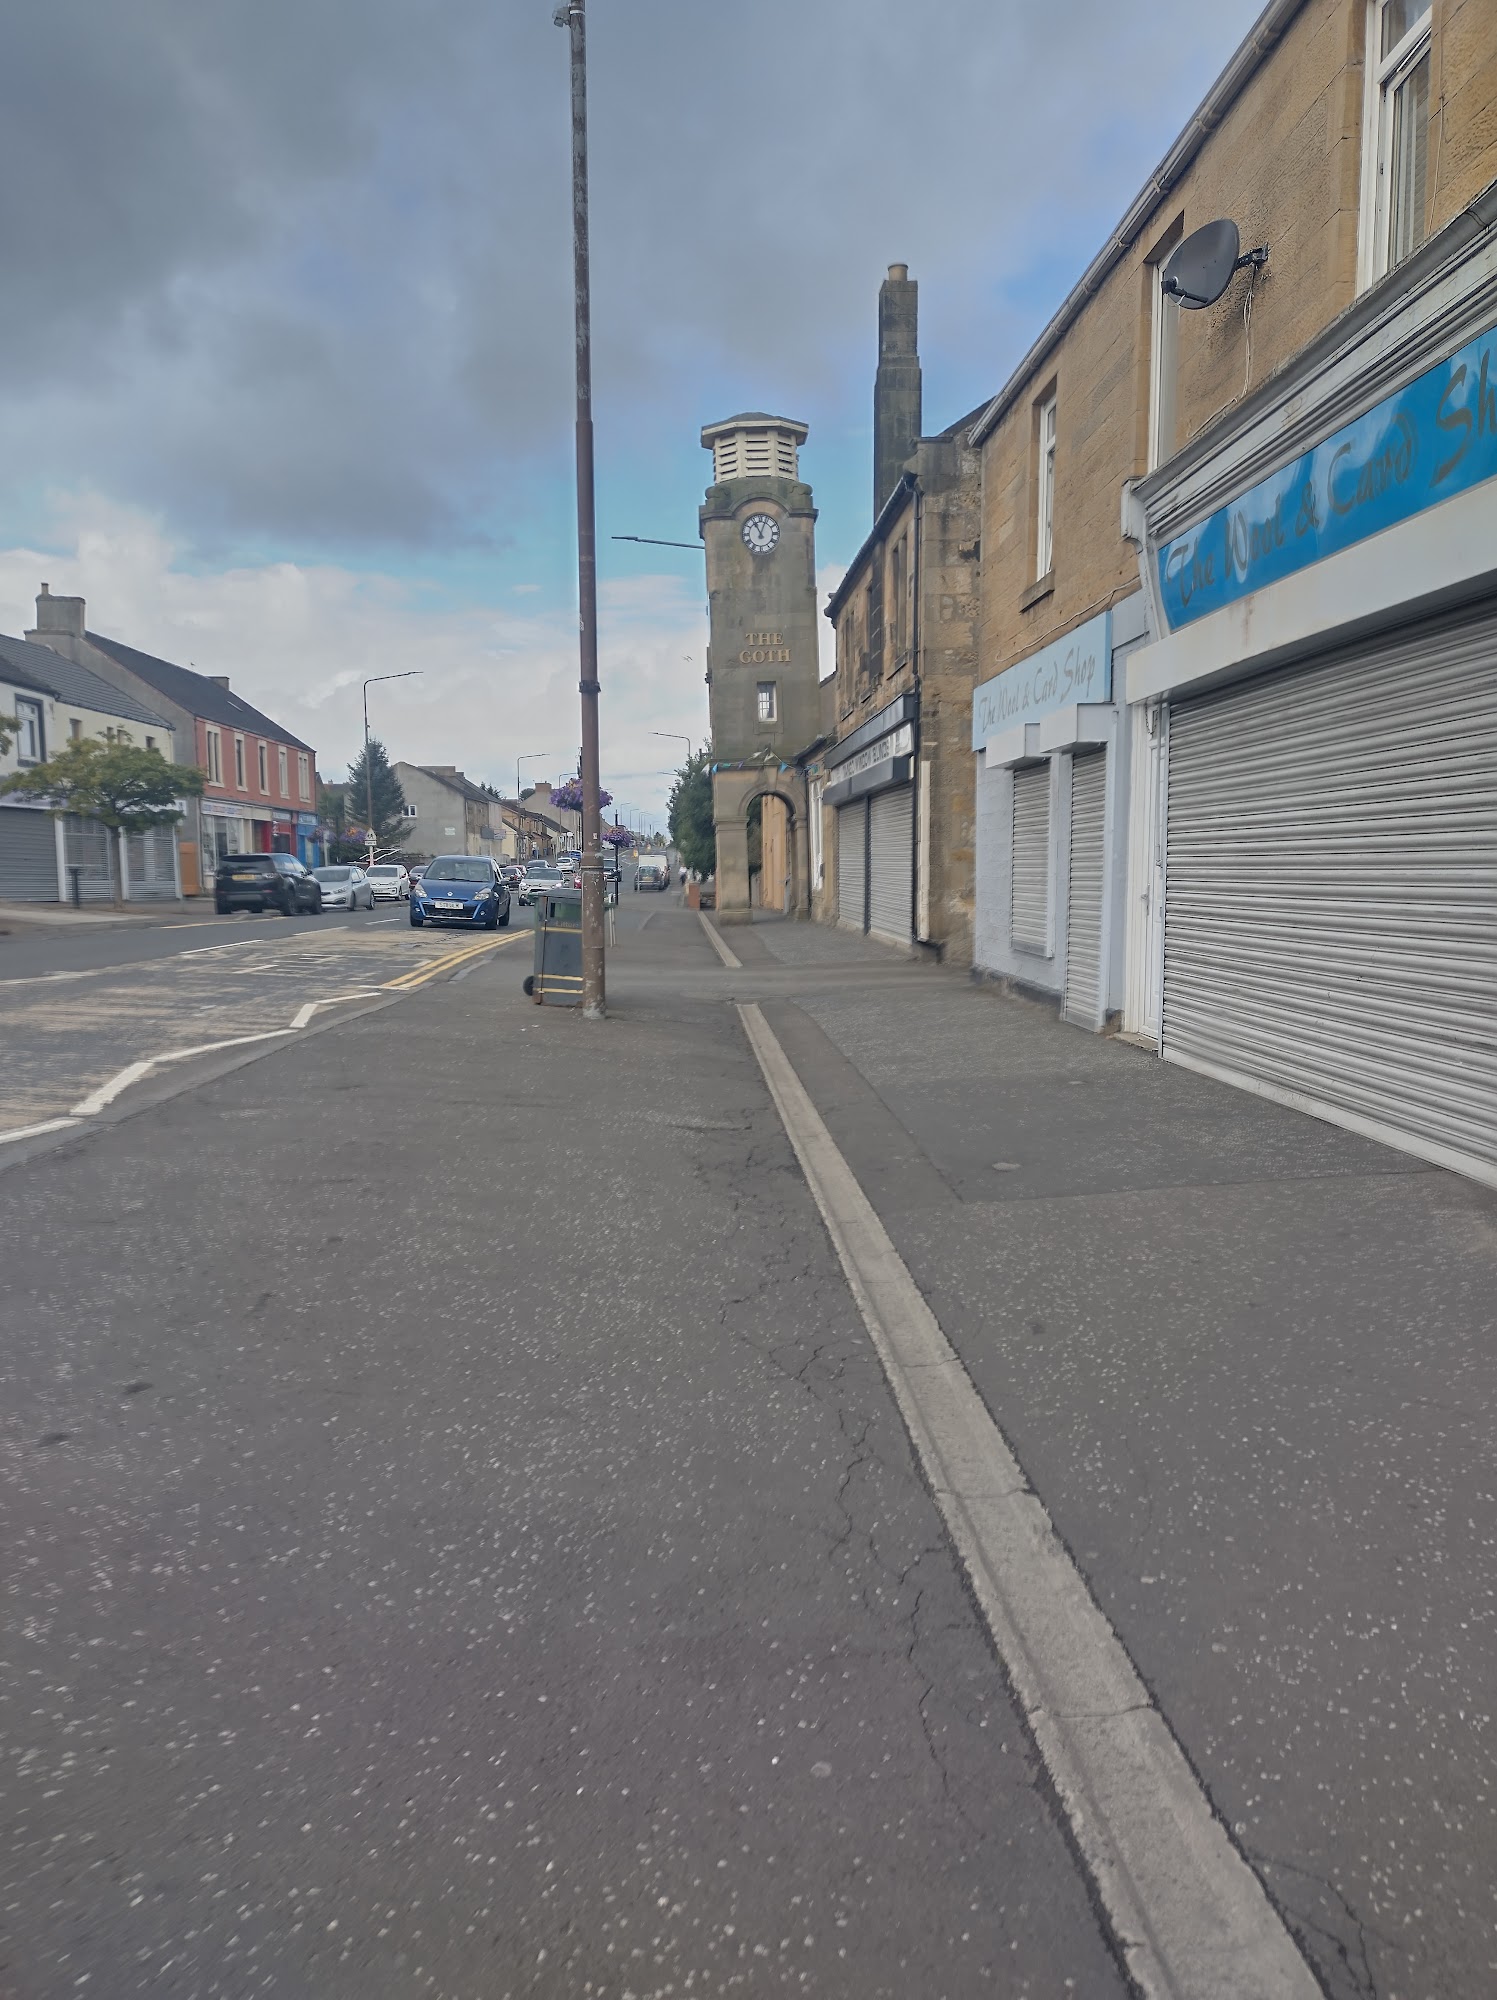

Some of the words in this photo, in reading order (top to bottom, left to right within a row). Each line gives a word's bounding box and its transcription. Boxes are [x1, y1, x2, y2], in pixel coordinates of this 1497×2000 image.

[1166, 536, 1215, 608] The
[1224, 492, 1285, 578] Wool
[1295, 480, 1320, 537] &
[1327, 411, 1415, 515] Card
[739, 648, 792, 664] GOTH
[745, 632, 784, 646] THE
[979, 695, 996, 733] The
[998, 682, 1019, 722] Wool
[1021, 680, 1030, 710] &
[1033, 661, 1059, 705] Card
[1060, 646, 1096, 704] Shop
